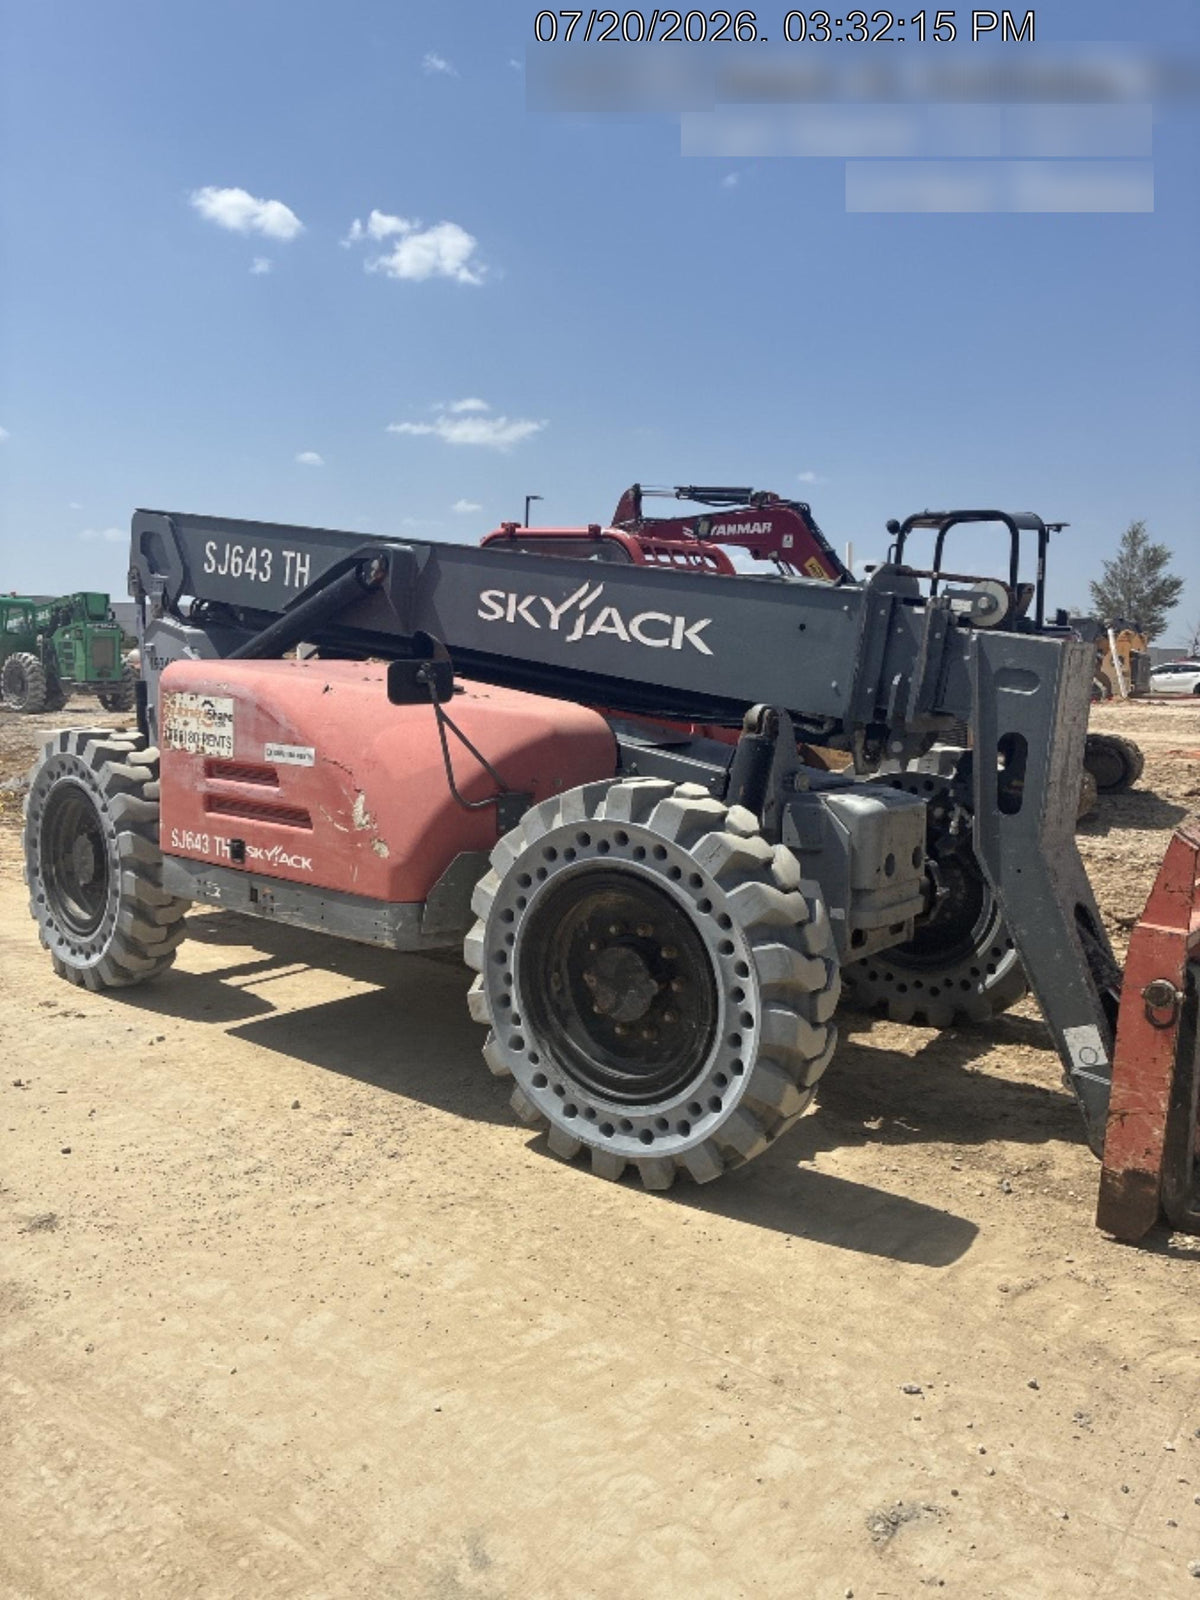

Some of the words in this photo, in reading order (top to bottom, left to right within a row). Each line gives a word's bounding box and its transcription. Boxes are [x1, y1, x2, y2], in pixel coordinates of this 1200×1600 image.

[203, 541, 272, 583] SJ643
[282, 550, 310, 588] TH
[477, 579, 713, 656] SKYJACK
[171, 828, 210, 854] SJ643
[245, 844, 314, 872] SKYJACK
